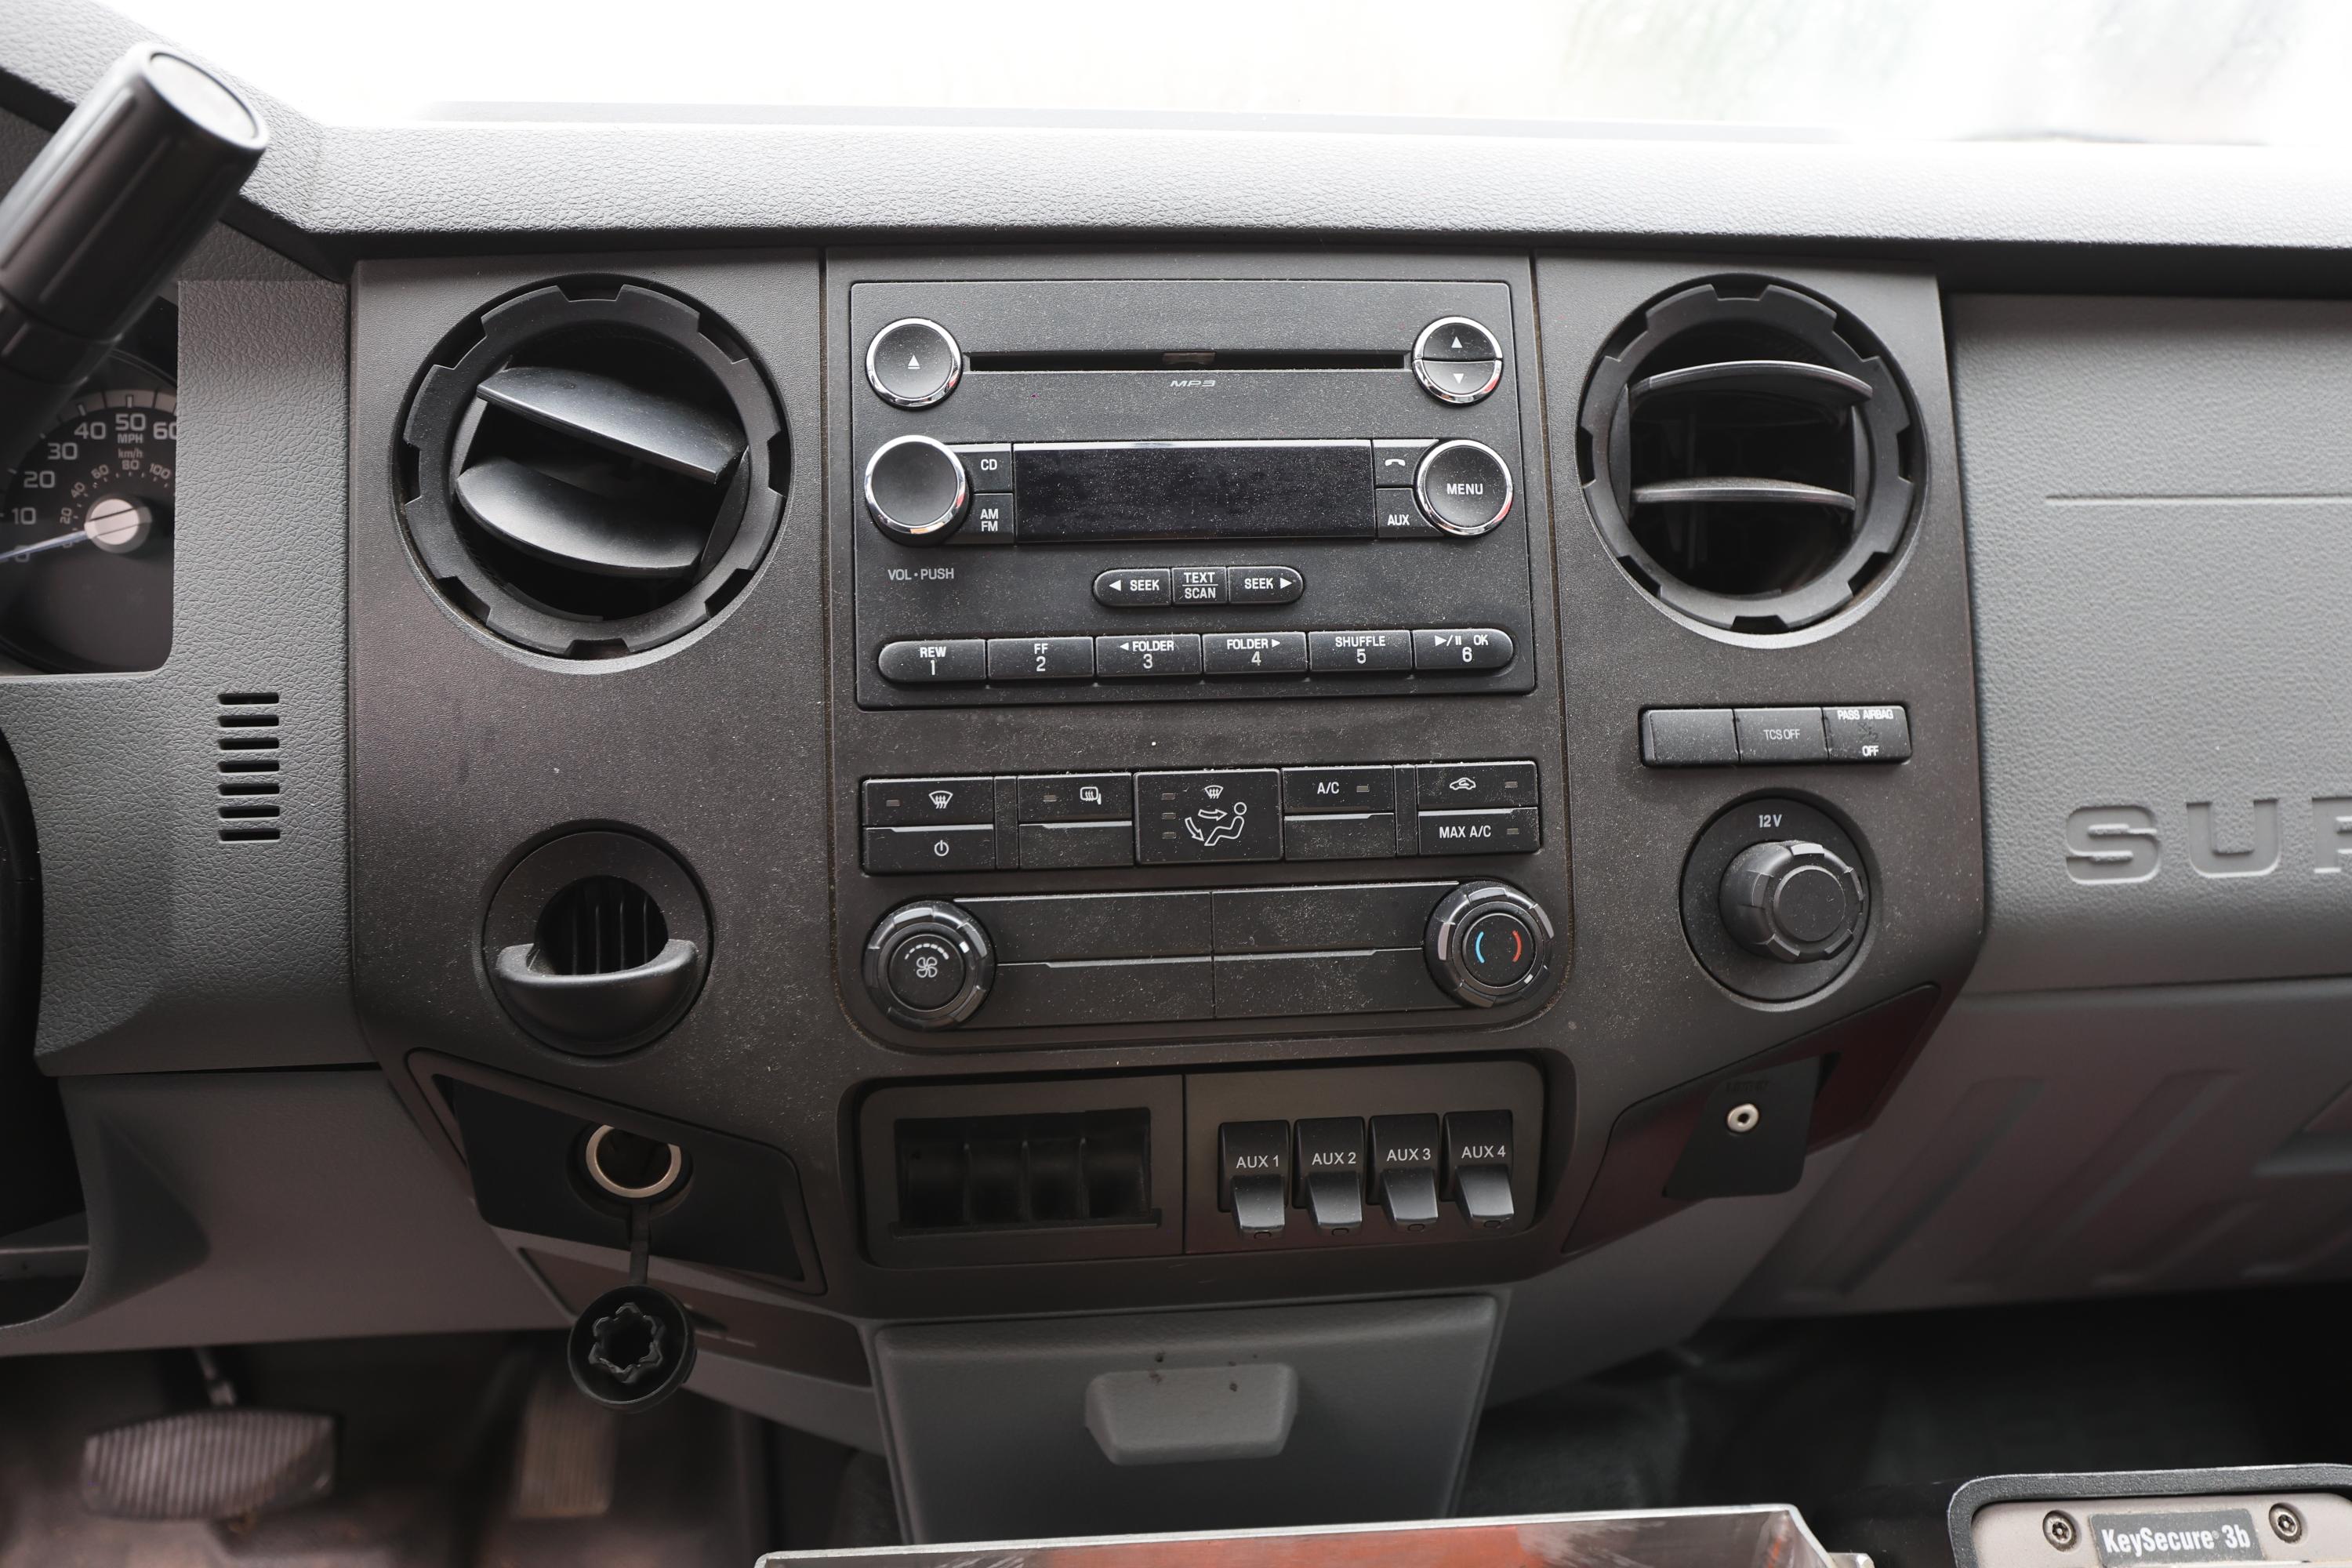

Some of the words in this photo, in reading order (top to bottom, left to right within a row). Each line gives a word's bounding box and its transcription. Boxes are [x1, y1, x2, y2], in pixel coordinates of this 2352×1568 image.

[115, 413, 147, 431] 50
[74, 422, 107, 440] 40
[117, 434, 143, 443] MPH
[47, 442, 78, 460] 30
[118, 448, 143, 459] km/h
[122, 460, 140, 470] 80
[149, 463, 172, 480] 100
[980, 459, 998, 471] CD
[91, 464, 110, 480] 60
[24, 470, 56, 488] 20
[71, 481, 85, 499] 40
[1446, 483, 1483, 495] MENU
[12, 507, 36, 524] 10
[60, 507, 72, 524] 20
[980, 509, 999, 520] AM
[1387, 514, 1410, 526] AUX
[980, 521, 999, 532] FM
[1184, 572, 1215, 584] TEXT
[1244, 578, 1274, 590] SEEK
[1130, 579, 1160, 591] SEEK
[1184, 587, 1216, 599] SCAN
[1132, 641, 1174, 652] FOLDER
[1226, 638, 1269, 650] FOLDER
[1335, 636, 1386, 648] SHUFFLE
[1473, 634, 1489, 646] OK
[920, 647, 946, 659] REW
[1034, 643, 1049, 655] FF
[1461, 646, 1473, 662] 6
[1142, 653, 1153, 670] 3
[1250, 651, 1261, 666] 4
[1356, 648, 1367, 664] 5
[930, 659, 936, 676] 1
[1036, 656, 1046, 672] 2
[1837, 709, 1860, 720] PASS
[1863, 709, 1894, 720] AIRBAG
[1763, 729, 1782, 741] TCS
[1784, 728, 1801, 739] OFF
[1862, 745, 1879, 757] OFF
[1317, 782, 1340, 795] A/C
[1439, 826, 1465, 839] MAX
[1469, 825, 1492, 839] A/C
[1387, 1149, 1420, 1162] AUX
[1422, 1148, 1431, 1161] 3
[1461, 1145, 1494, 1159] AUX
[1497, 1145, 1506, 1158] 4
[1236, 1156, 1269, 1169] AUX
[1273, 1156, 1279, 1167] 1
[1312, 1152, 1345, 1166] AUX
[1348, 1152, 1356, 1165] 2
[2221, 1524, 2251, 1549] 3b
